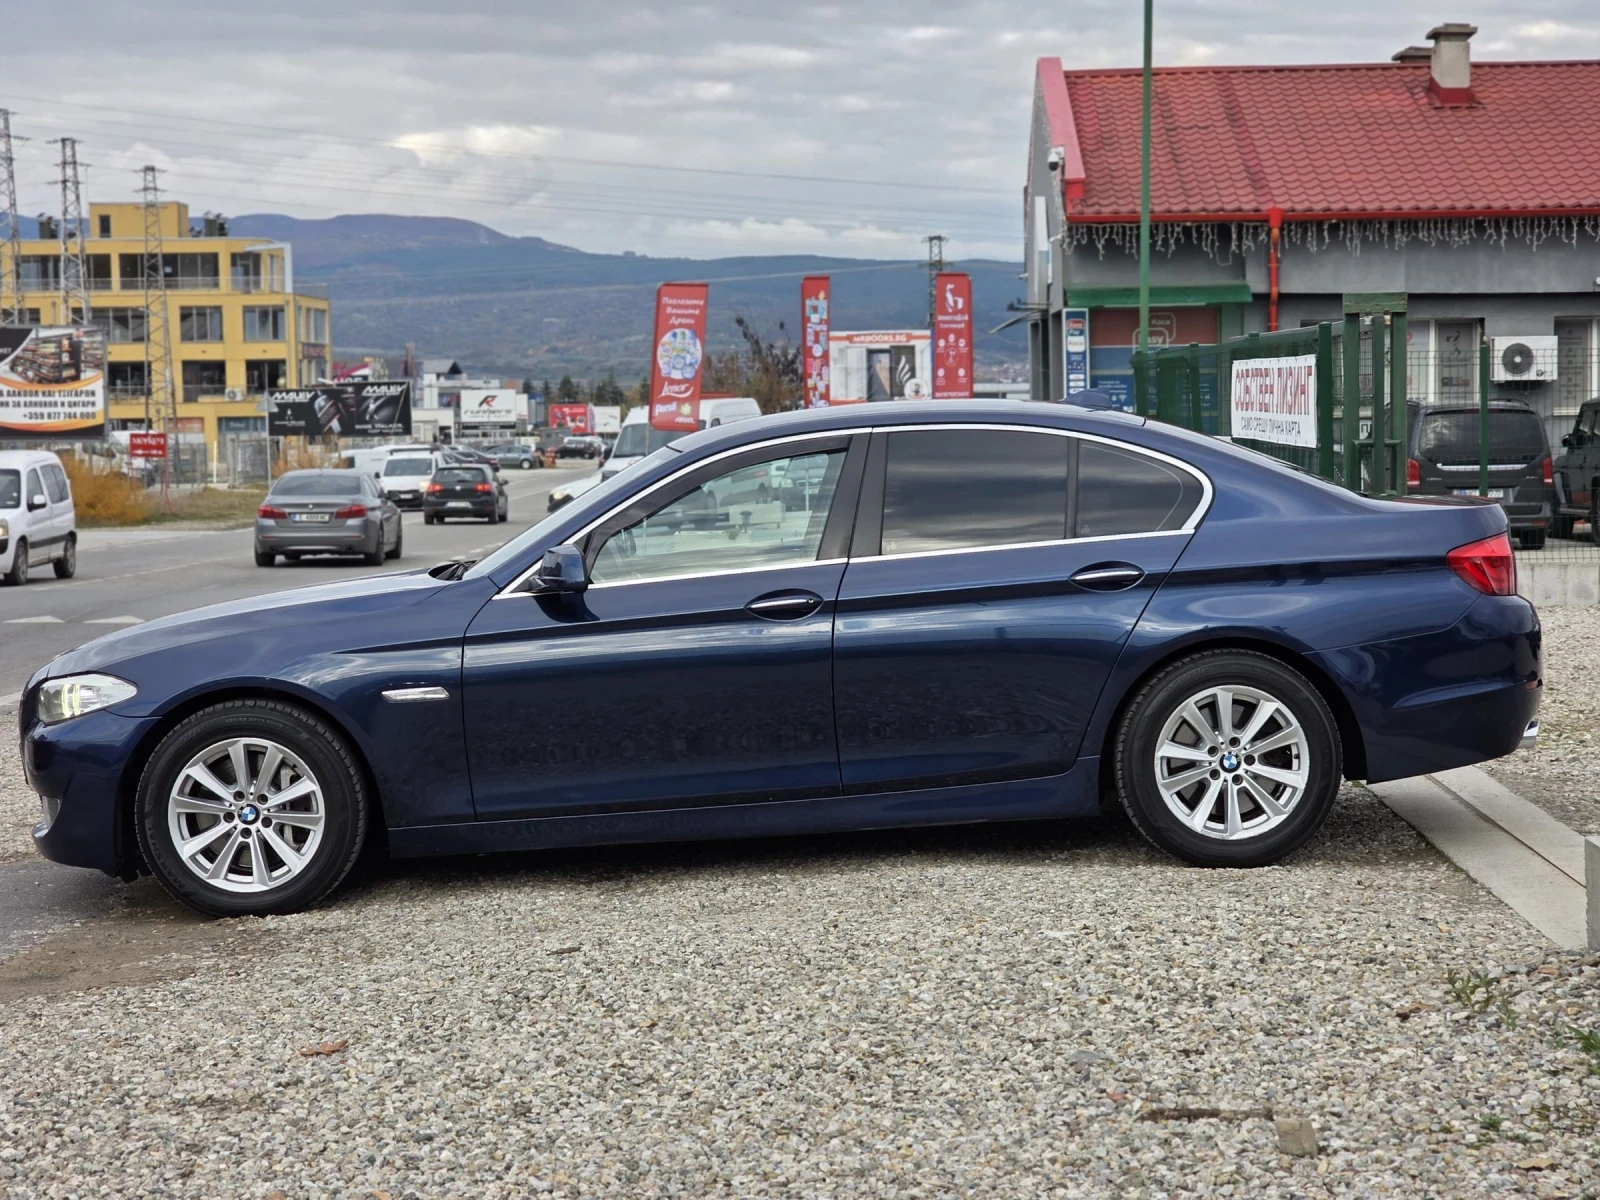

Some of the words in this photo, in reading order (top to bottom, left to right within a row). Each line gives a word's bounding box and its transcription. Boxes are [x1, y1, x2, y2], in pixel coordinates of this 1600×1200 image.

[660, 381, 691, 397] Lenor
[1235, 367, 1275, 413] СОБСТВЕН
[1275, 365, 1312, 415] ЛИЗИНГ
[22, 411, 45, 420] +359
[1241, 416, 1253, 431] САМО
[1254, 417, 1268, 434] СРЕЩУ
[1269, 418, 1284, 435] ЛИЧНА
[1285, 420, 1301, 437] КАРТА
